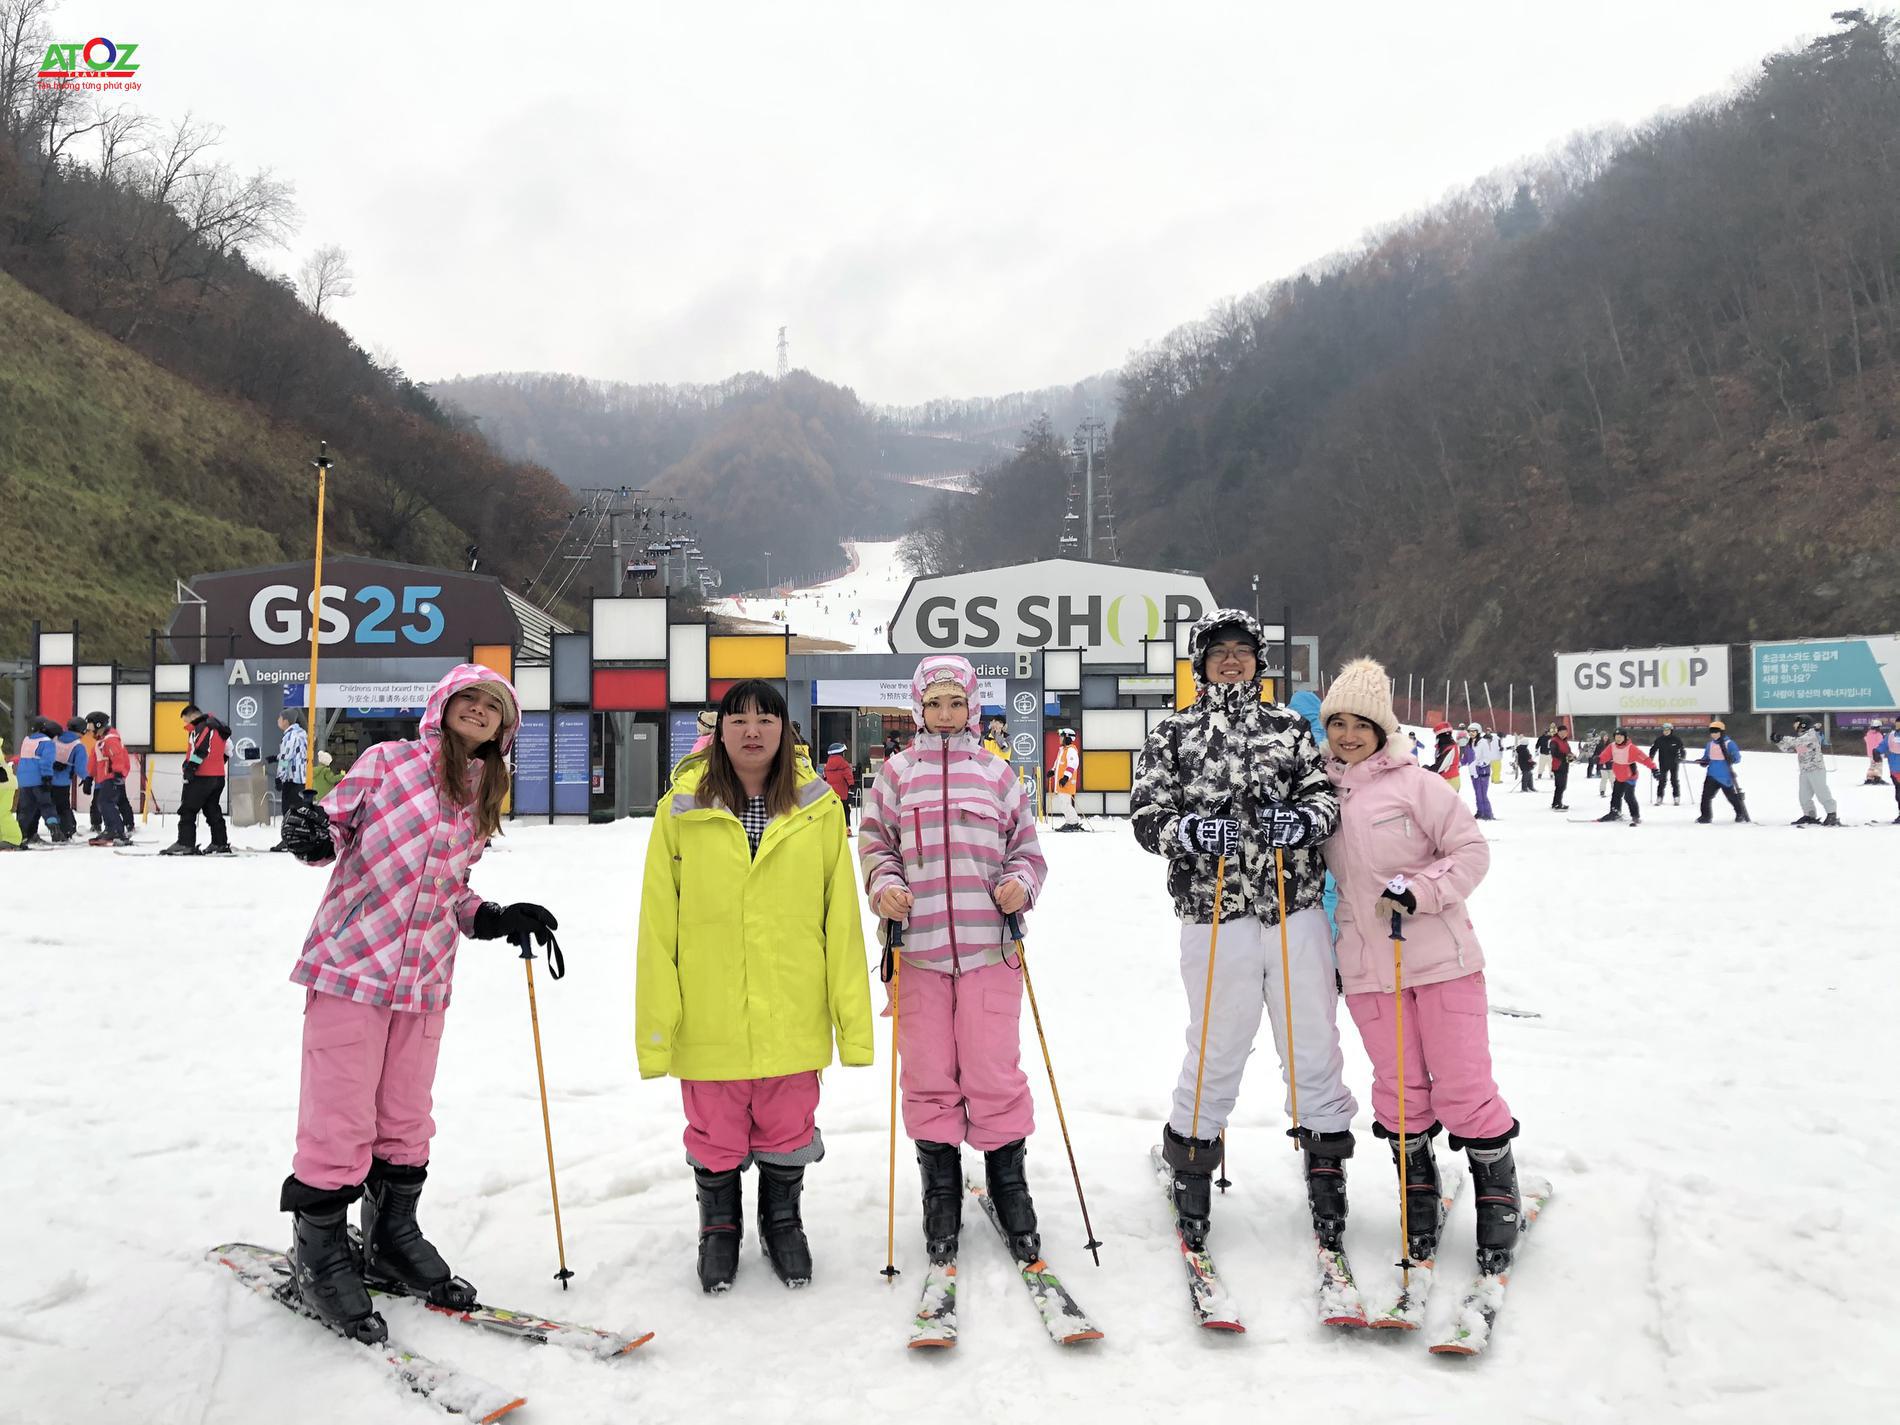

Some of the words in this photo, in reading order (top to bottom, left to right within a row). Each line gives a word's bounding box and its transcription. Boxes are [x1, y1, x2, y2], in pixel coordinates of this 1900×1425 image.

[249, 584, 445, 645] GS25
[916, 596, 1000, 648] GS
[1017, 594, 1203, 648] SHOP
[228, 660, 251, 685] A
[256, 670, 311, 684] beginner
[1014, 652, 1033, 679] B
[1574, 661, 1612, 690] GS
[1619, 657, 1709, 689] SHOP
